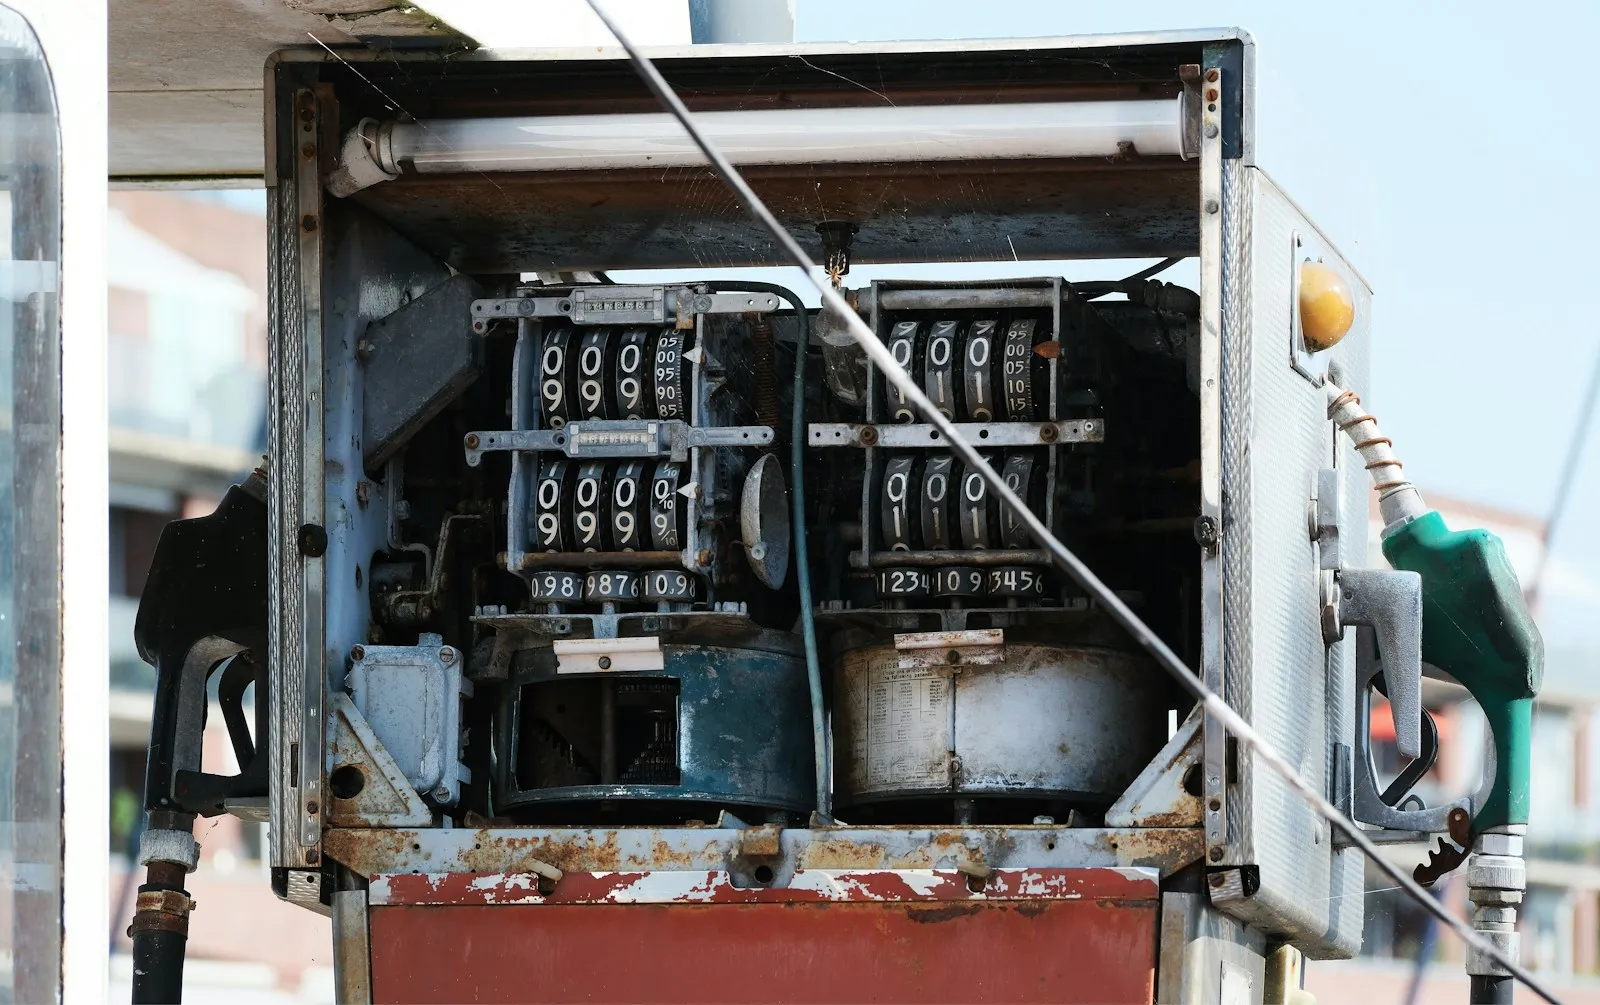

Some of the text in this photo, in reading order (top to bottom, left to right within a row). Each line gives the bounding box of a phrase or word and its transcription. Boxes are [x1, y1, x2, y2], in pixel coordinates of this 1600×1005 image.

[659, 337, 678, 348] 05
[1009, 331, 1027, 340] 95
[543, 344, 675, 376] 0 0 0 00
[892, 337, 1025, 367] 0 0 0 00
[656, 367, 675, 381] 95
[1006, 361, 1025, 375] 05
[543, 377, 675, 412] 9 9 9 90
[936, 370, 944, 403] 1
[975, 370, 983, 404] 1
[1009, 379, 1025, 394] 10
[659, 404, 677, 417] 85
[1010, 398, 1026, 411] 15
[539, 479, 558, 509] 0
[577, 478, 597, 508] 0
[616, 477, 635, 507] 0
[887, 473, 906, 502] 0
[927, 473, 946, 502] 0
[965, 473, 985, 502] 0
[538, 513, 558, 546] 9
[577, 511, 596, 544] 9
[615, 511, 635, 544] 9
[893, 506, 900, 538] 1
[932, 507, 940, 539] 1
[971, 506, 979, 539] 1
